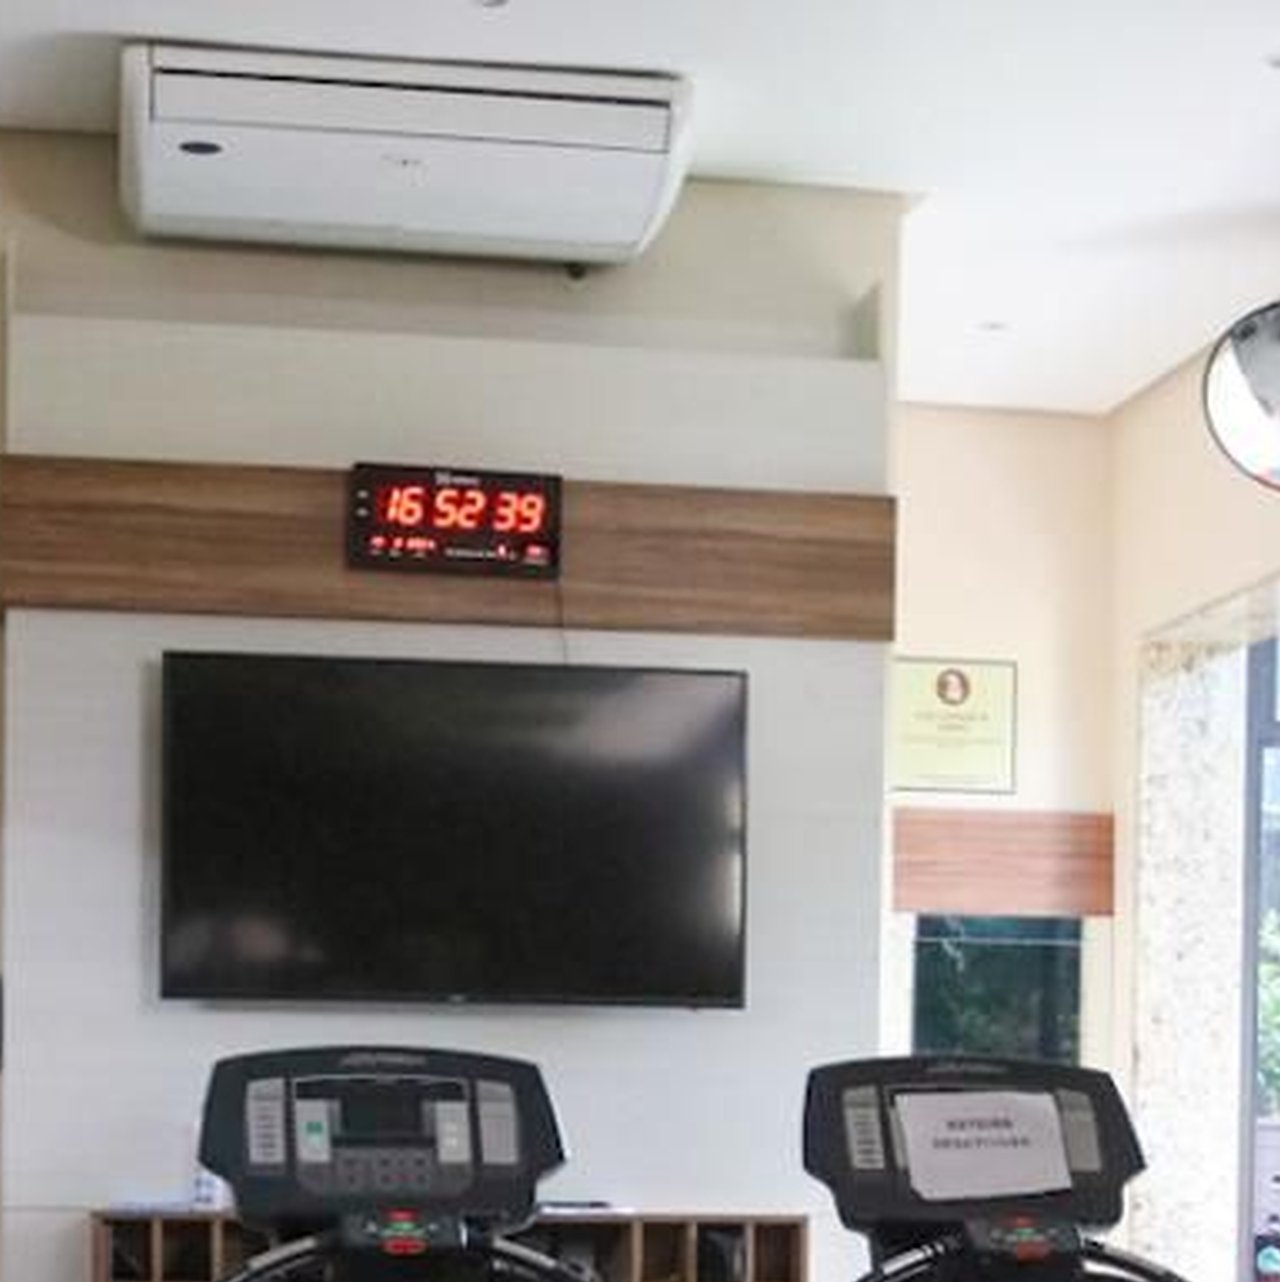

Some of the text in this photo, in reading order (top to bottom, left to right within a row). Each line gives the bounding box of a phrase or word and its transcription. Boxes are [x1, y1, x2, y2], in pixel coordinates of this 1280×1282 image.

[386, 486, 544, 533] 16 52 39
